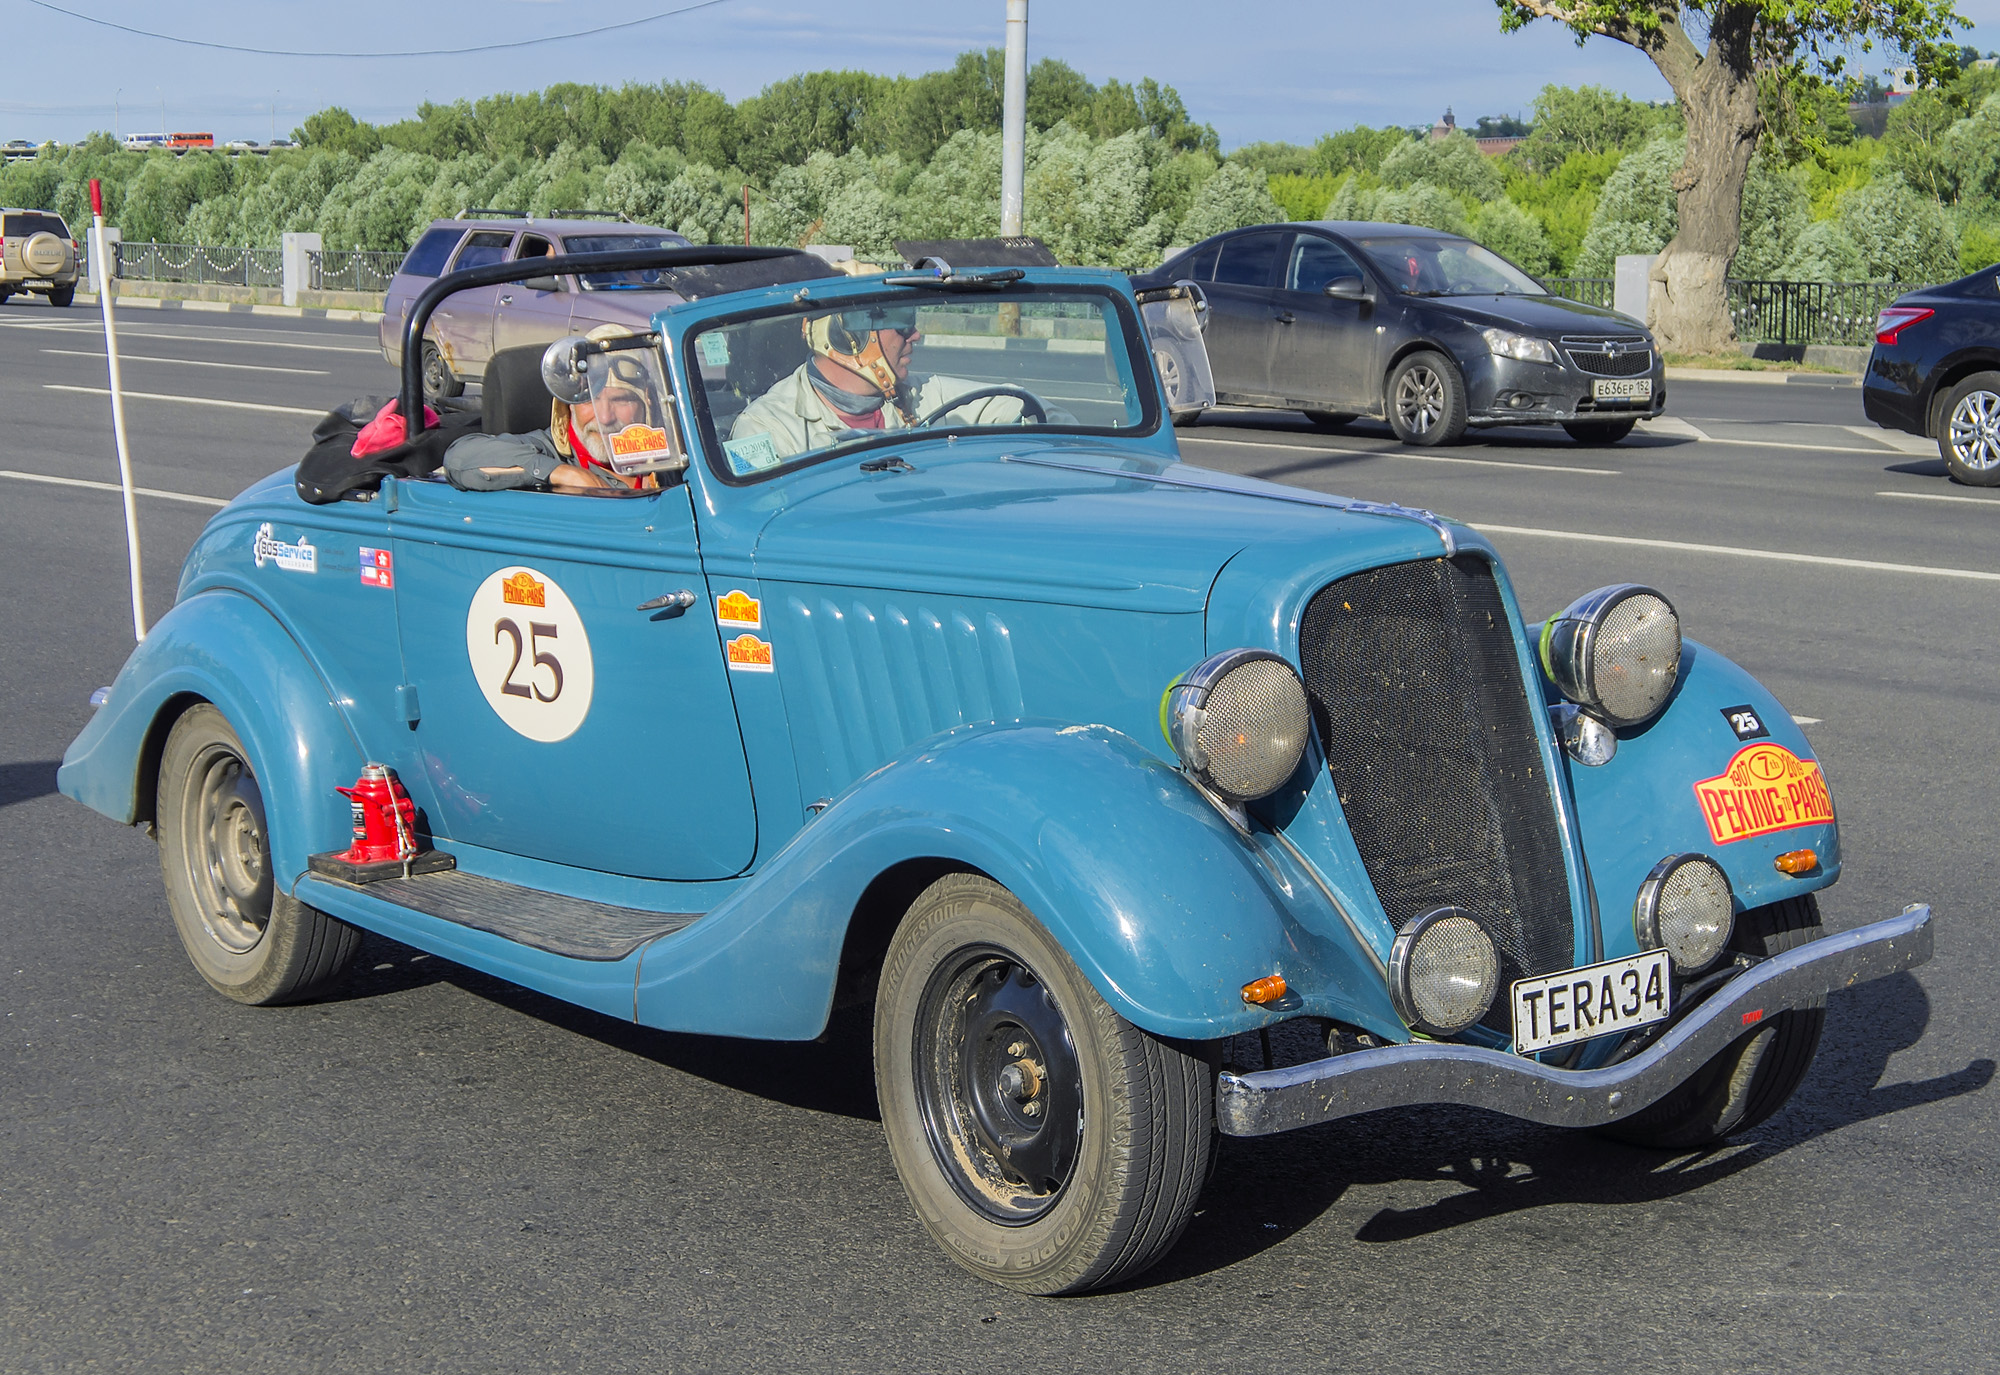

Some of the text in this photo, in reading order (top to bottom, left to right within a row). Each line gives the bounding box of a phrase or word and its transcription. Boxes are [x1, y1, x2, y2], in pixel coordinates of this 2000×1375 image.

[1636, 381, 1650, 391] 152
[613, 437, 641, 453] PEKING
[643, 431, 665, 450] PARIS
[504, 581, 525, 603] PEKING
[526, 585, 545, 605] PARIS
[494, 617, 564, 703] 25
[728, 644, 770, 663] PEKING PARIS
[1730, 711, 1760, 734] 25
[1730, 752, 1804, 788] 1907 7th 2019
[1701, 786, 1788, 838] PEKING
[1786, 767, 1833, 820] PARIS
[1522, 963, 1664, 1040] TERA34
[1742, 1008, 1763, 1025] TOW
